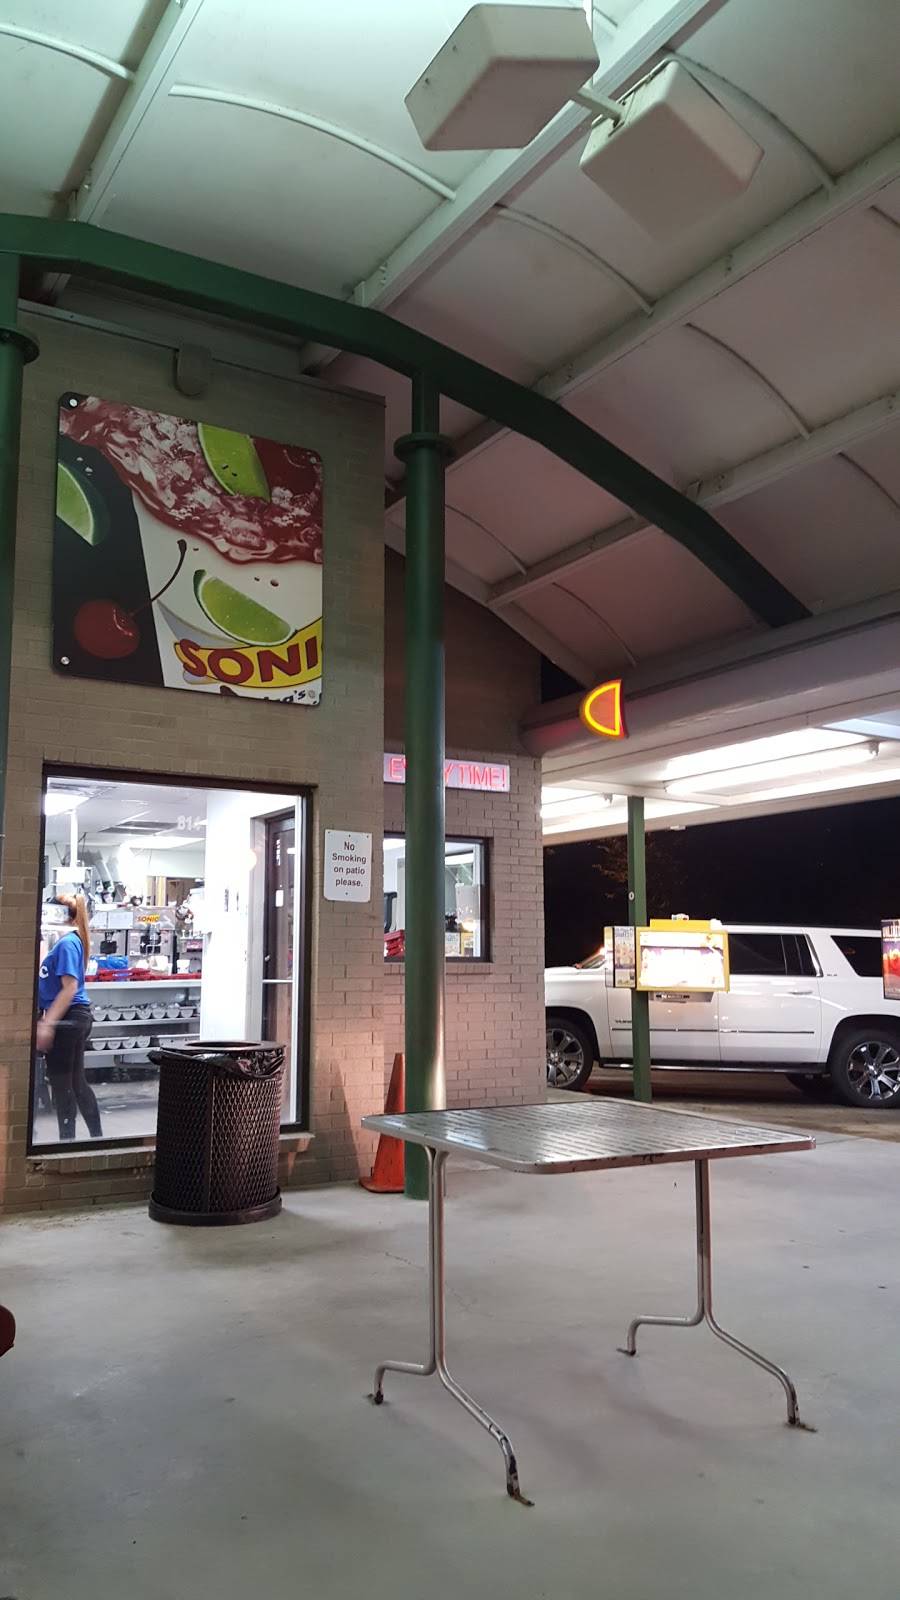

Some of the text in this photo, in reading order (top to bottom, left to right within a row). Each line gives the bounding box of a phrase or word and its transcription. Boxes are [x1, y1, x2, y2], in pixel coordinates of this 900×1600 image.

[180, 636, 322, 684] SONI
[344, 841, 355, 851] No
[332, 852, 367, 864] Smoking
[346, 866, 366, 875] patio
[335, 878, 363, 887] please.
